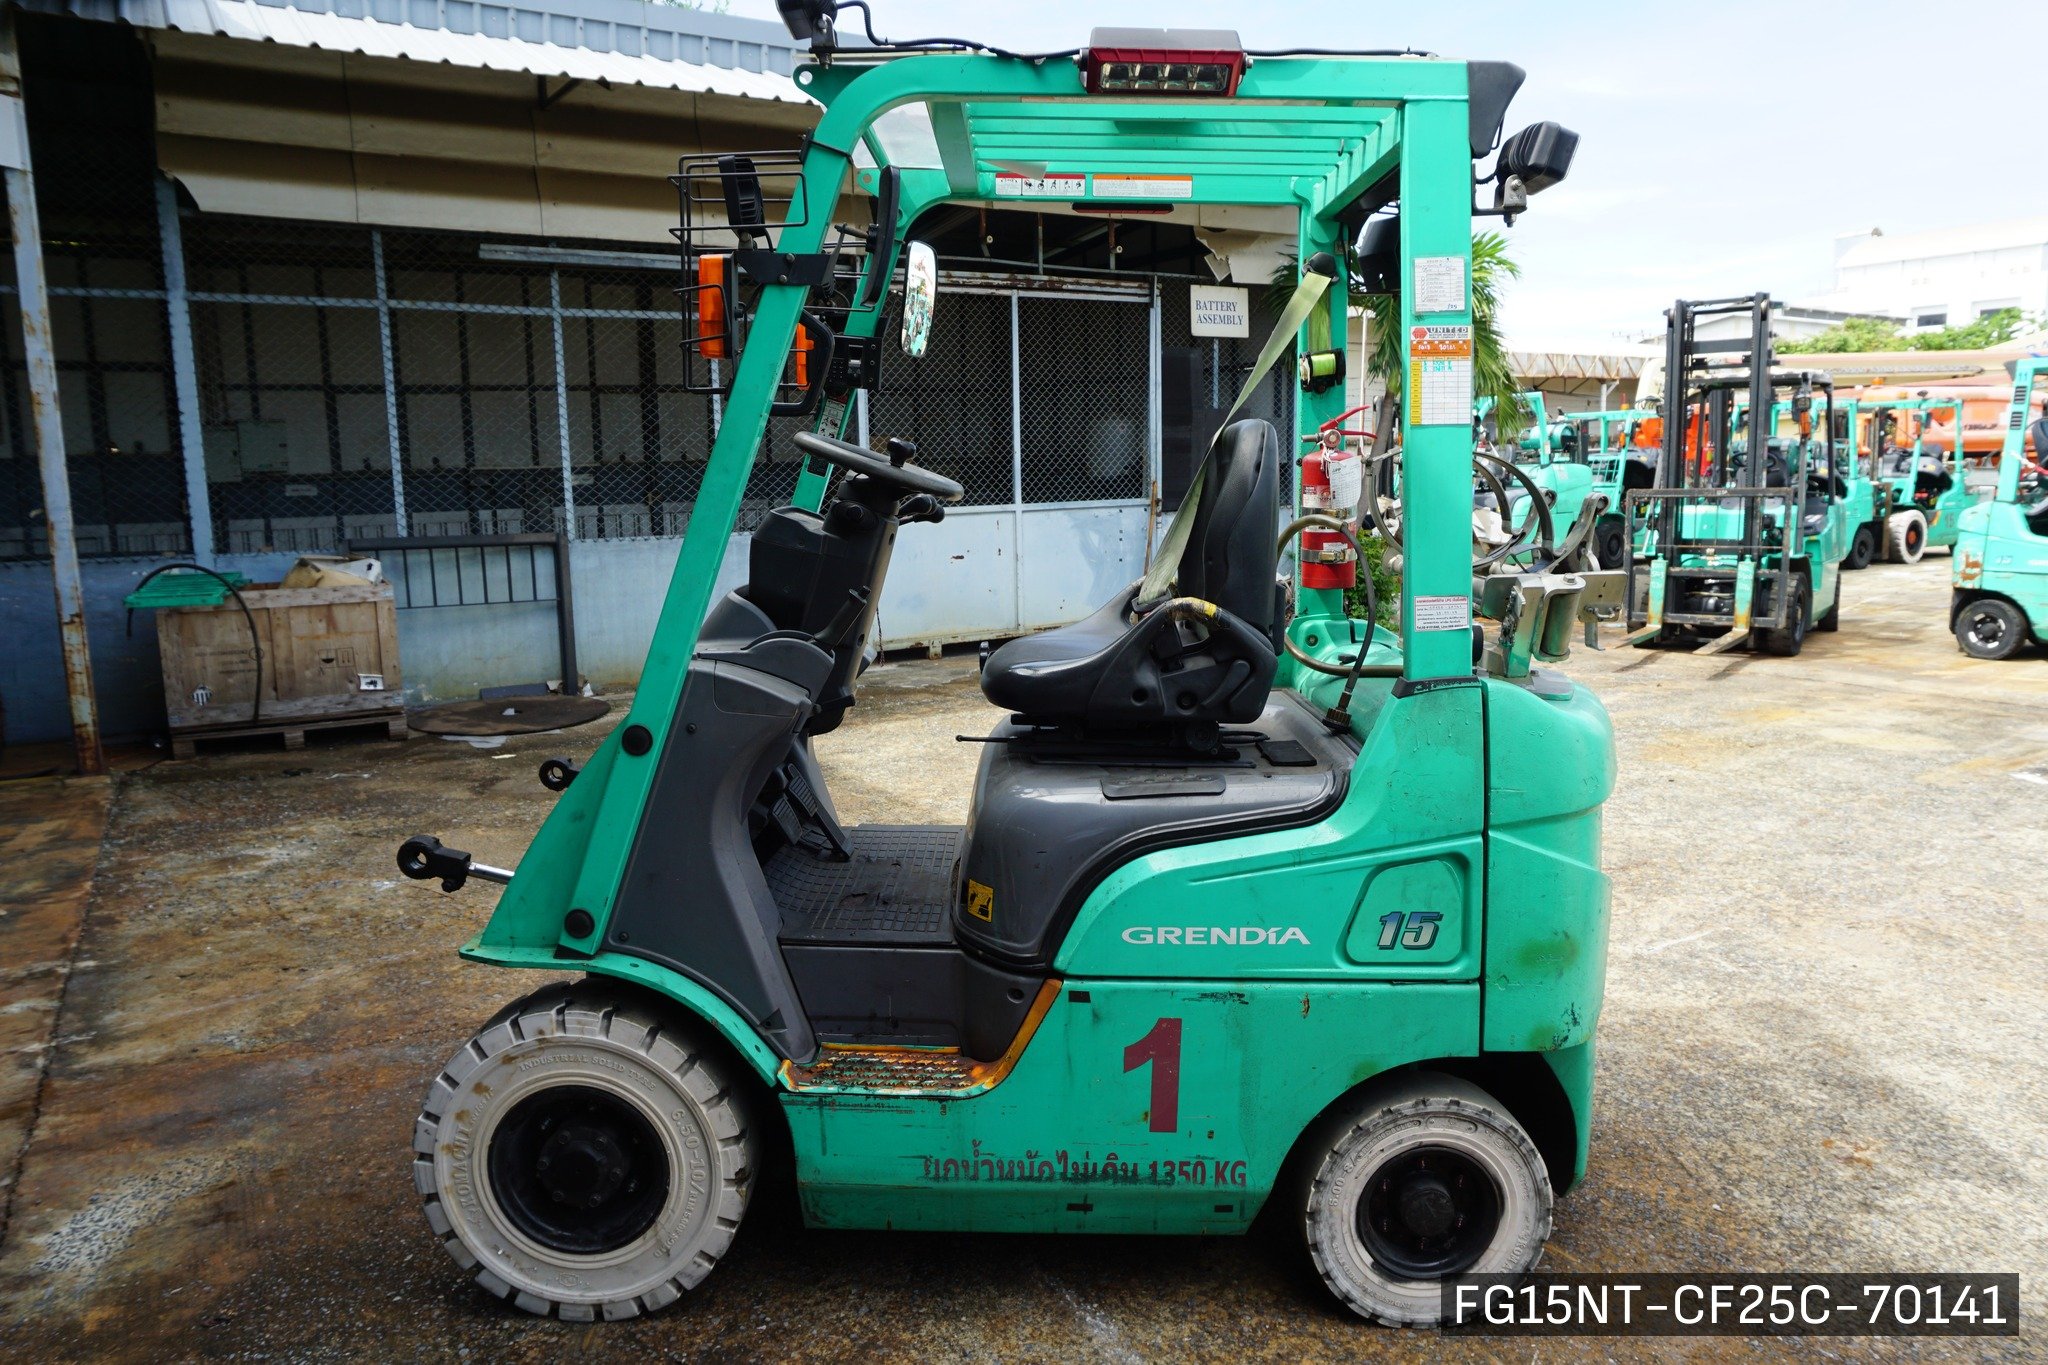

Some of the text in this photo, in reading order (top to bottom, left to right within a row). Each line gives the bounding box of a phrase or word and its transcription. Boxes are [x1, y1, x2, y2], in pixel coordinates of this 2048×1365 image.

[1195, 299, 1237, 312] BATTERY
[1197, 313, 1243, 325] ASSEMBLY
[1377, 911, 1442, 950] 15
[520, 1054, 657, 1092] INDUSTRIAL SOLID TYRE
[1123, 1017, 1182, 1133] 1
[452, 1126, 476, 1209] KOMACHI
[1149, 1159, 1248, 1187] 1350 KG
